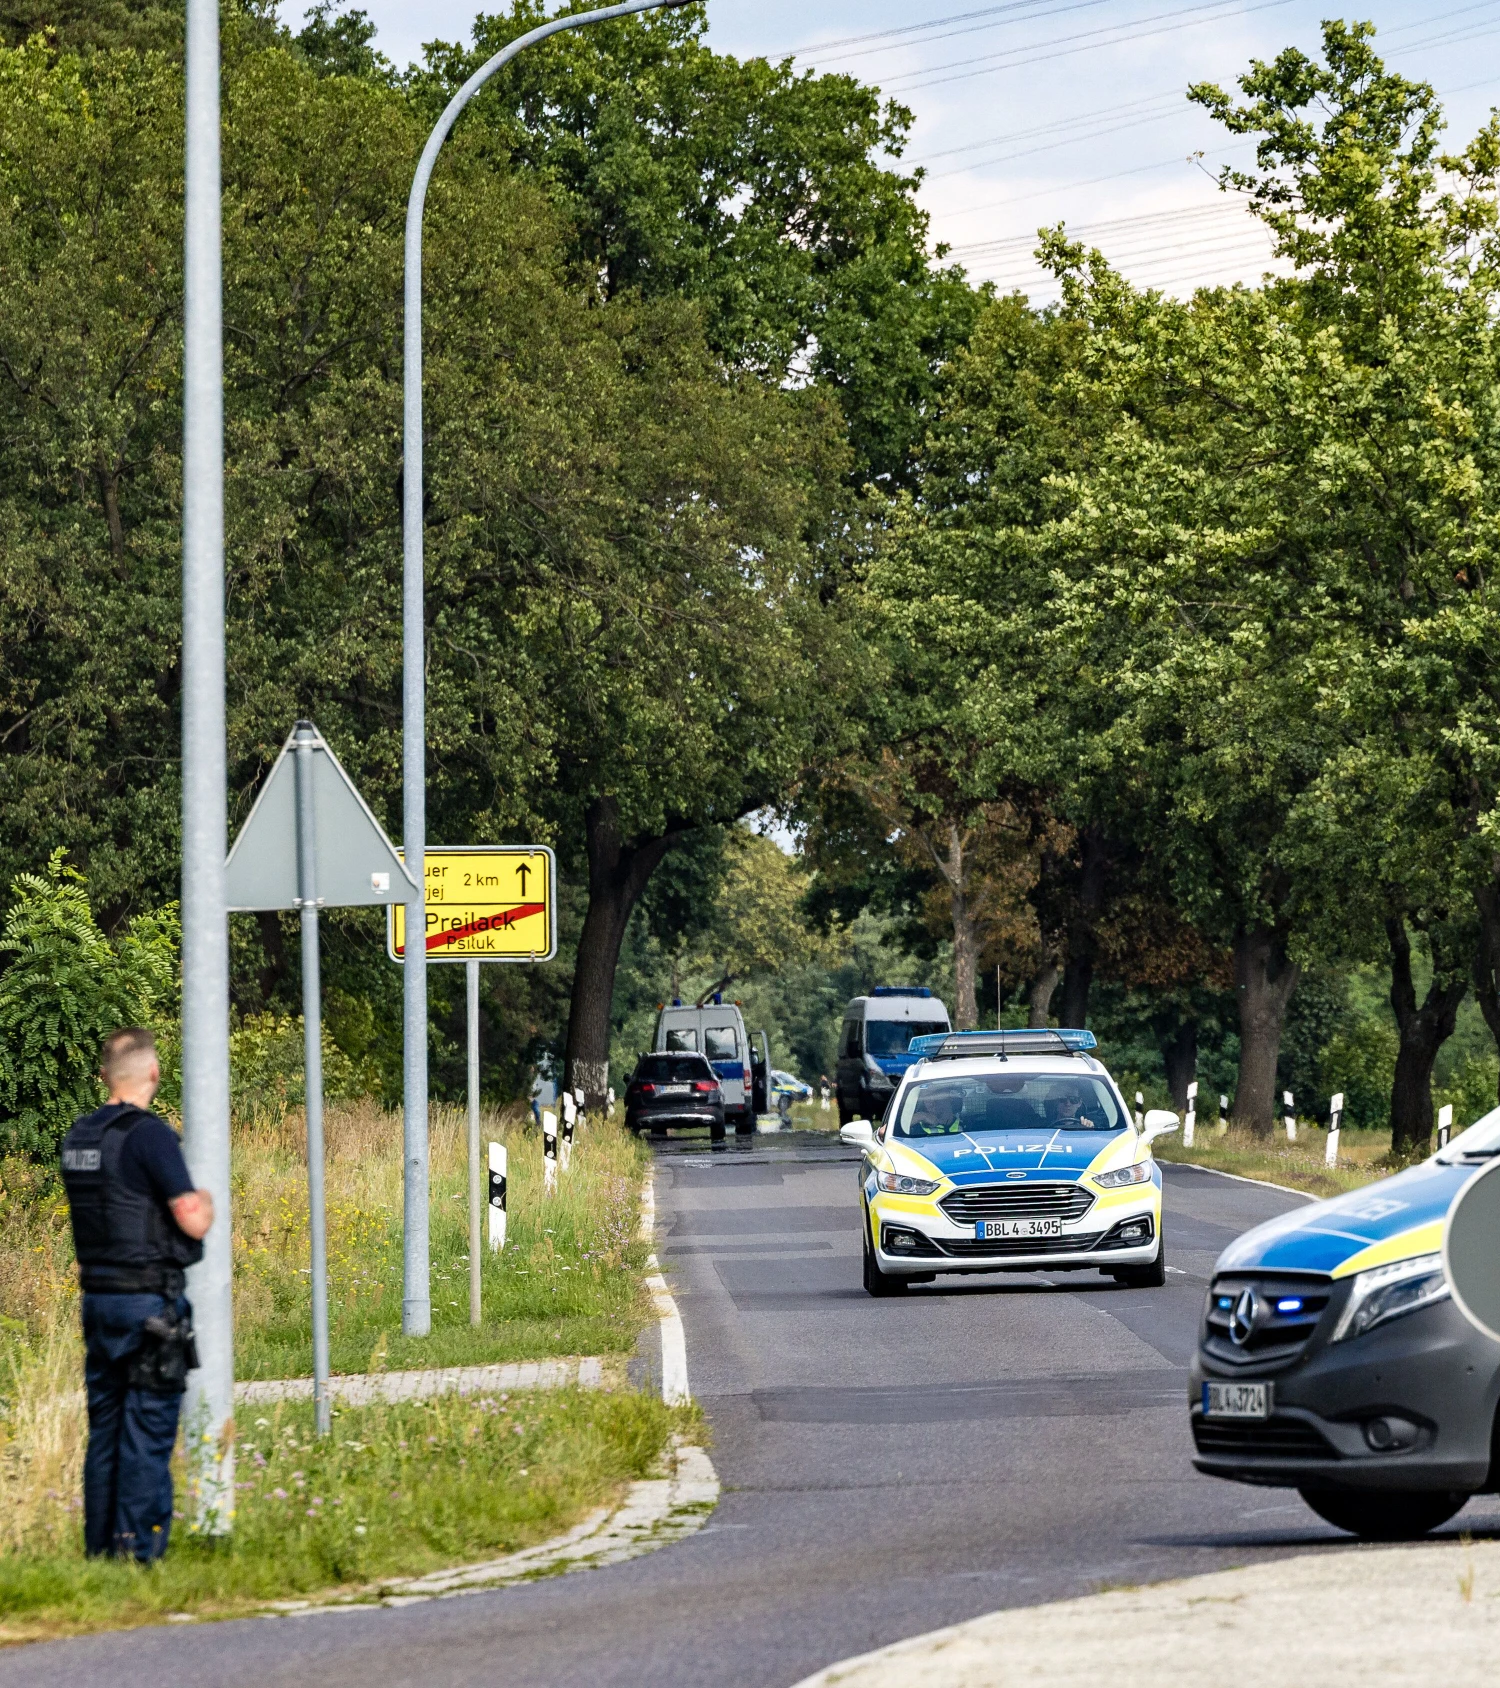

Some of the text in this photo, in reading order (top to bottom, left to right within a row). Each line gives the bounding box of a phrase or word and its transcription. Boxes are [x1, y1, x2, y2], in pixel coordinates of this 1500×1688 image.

[425, 866, 449, 877] uer
[463, 873, 499, 886] 2 km
[425, 884, 444, 901] jej
[425, 912, 516, 932] Preilack
[953, 1144, 1073, 1158] POLIZEI
[986, 1220, 1059, 1237] BBL 4 3495
[1237, 1387, 1263, 1412] 3724
